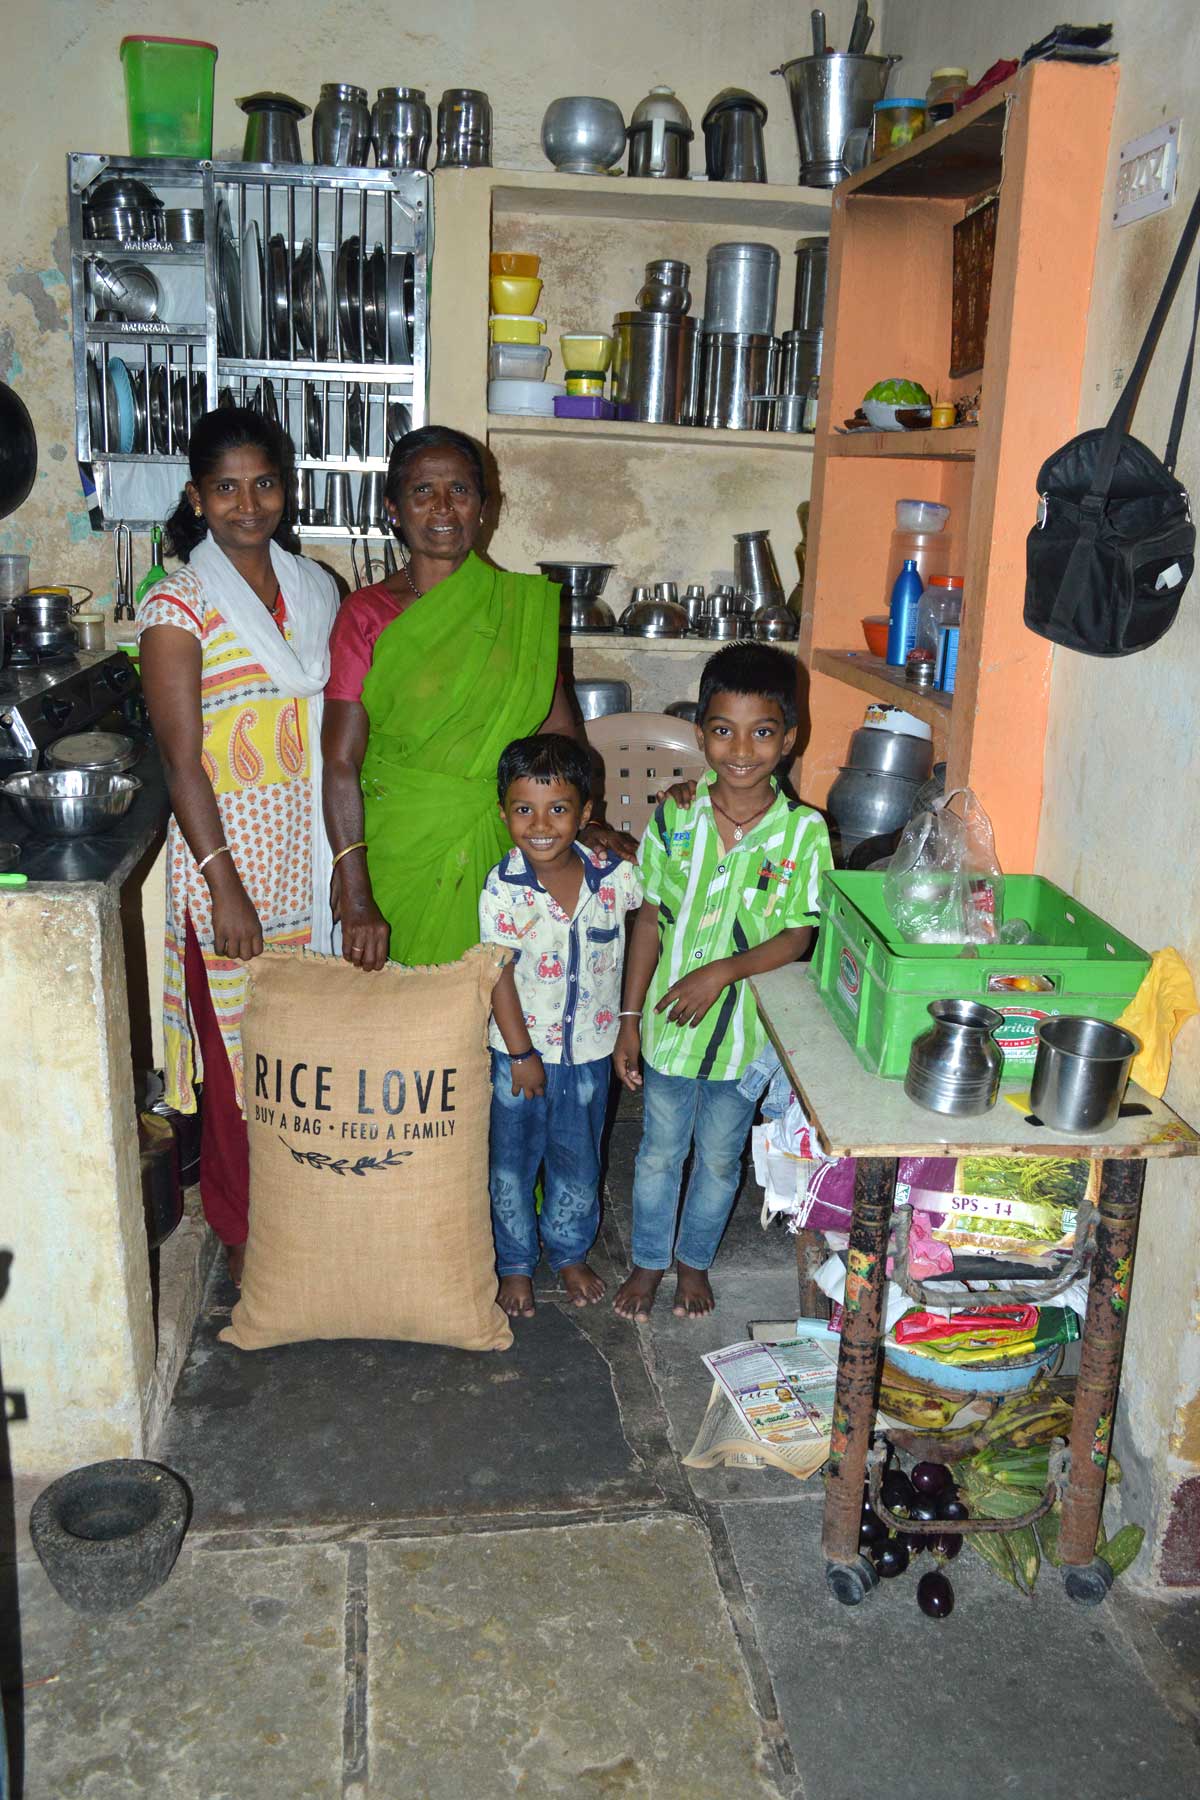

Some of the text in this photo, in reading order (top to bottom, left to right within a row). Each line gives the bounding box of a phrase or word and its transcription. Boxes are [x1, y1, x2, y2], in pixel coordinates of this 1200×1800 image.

[124, 241, 174, 251] MAHARAJA
[121, 322, 170, 333] MAHARAJA
[995, 1022, 1036, 1035] eritag
[255, 1053, 457, 1115] RICE LOVE
[255, 1104, 456, 1140] BUY A BAG FEED A FAMILY
[951, 1196, 979, 1211] SPS
[994, 1202, 1012, 1216] 14
